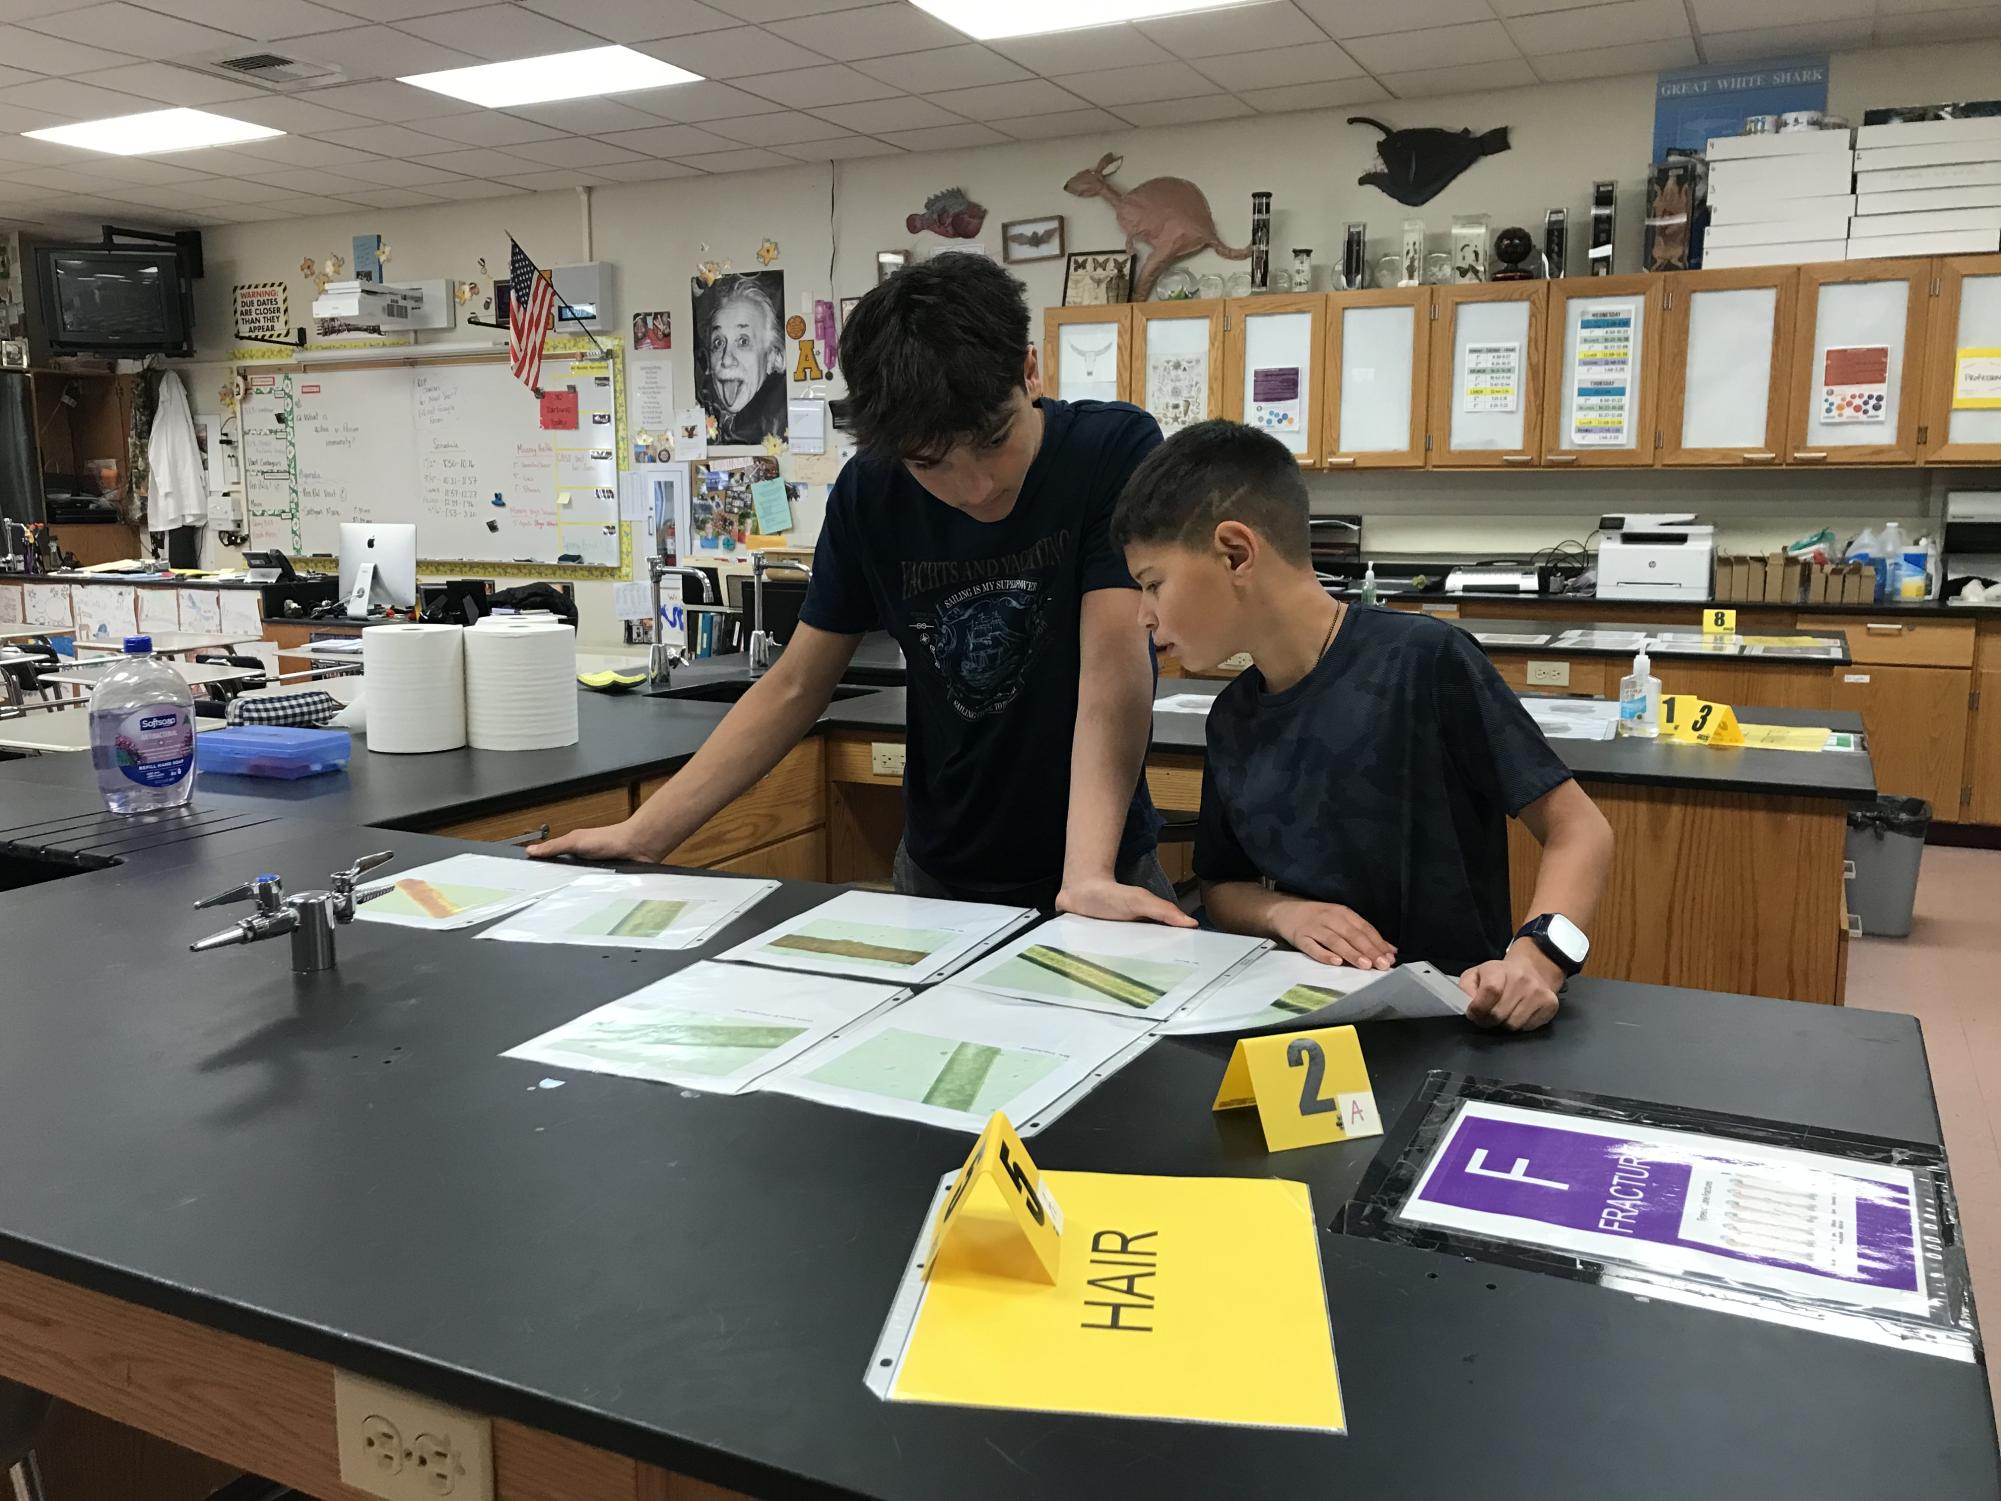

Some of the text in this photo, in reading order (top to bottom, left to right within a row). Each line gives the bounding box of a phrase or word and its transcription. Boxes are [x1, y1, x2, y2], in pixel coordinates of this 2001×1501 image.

[1660, 68, 1826, 98] GREAT WHITE SHARK
[241, 289, 279, 299] WARNING:
[241, 298, 279, 308] DUE DATES
[240, 306, 281, 317] ARE CLOSER
[241, 315, 281, 325] THAN THEY
[793, 340, 823, 382] A
[961, 559, 999, 580] AND
[943, 587, 973, 609] SAILING
[973, 584, 982, 596] IS
[982, 581, 996, 593] MY
[1714, 611, 1725, 627] 8
[142, 717, 176, 729] Softsoap
[1662, 696, 1713, 732] 1 3
[1287, 1038, 1337, 1116] 2
[1351, 1099, 1365, 1125] A
[1000, 1139, 1045, 1227] 5
[1464, 1148, 1570, 1191] F
[1598, 1154, 1651, 1234] FRACTUR
[1081, 1229, 1158, 1332] HAIR
